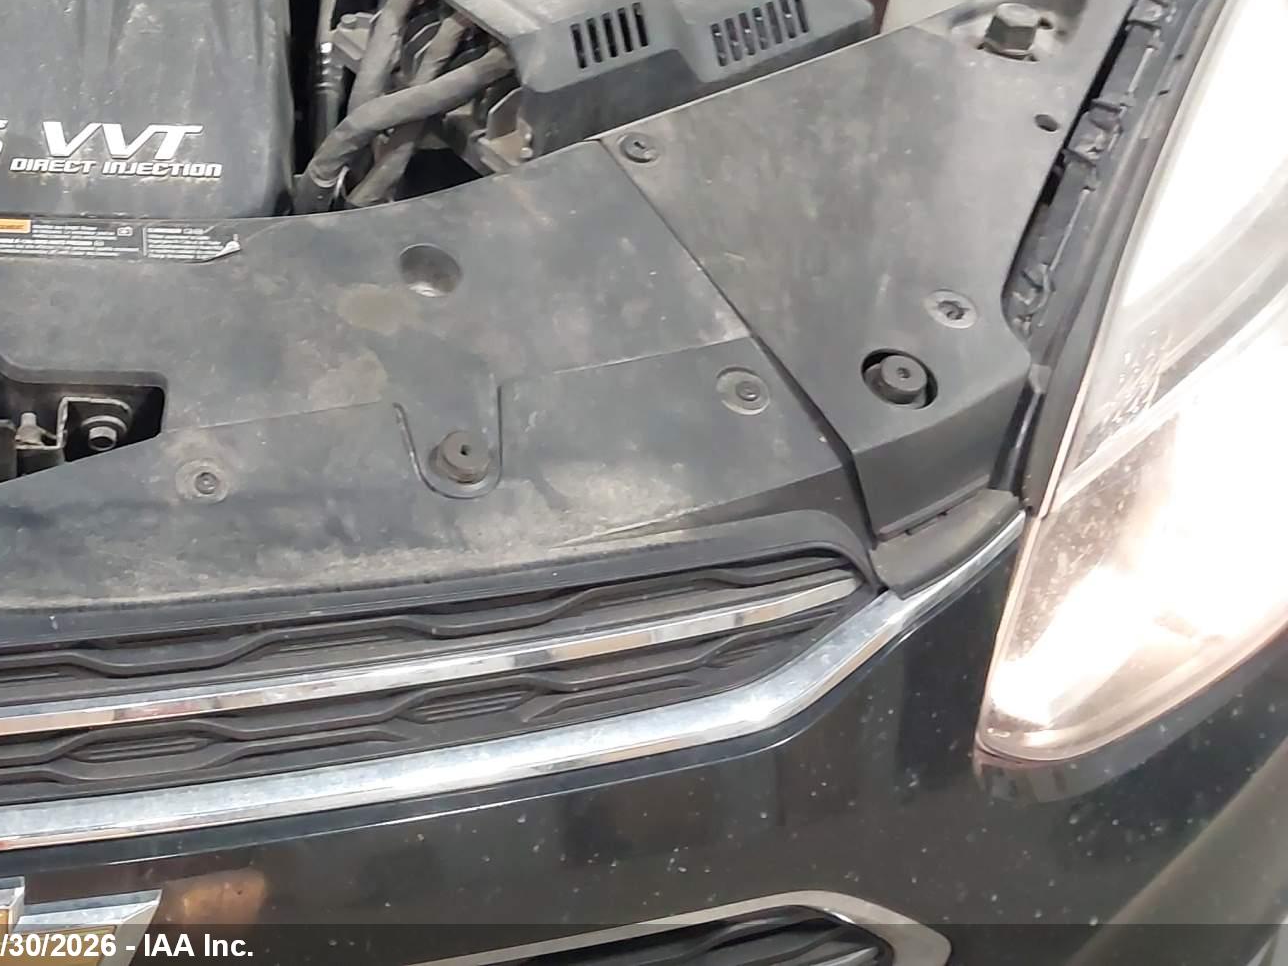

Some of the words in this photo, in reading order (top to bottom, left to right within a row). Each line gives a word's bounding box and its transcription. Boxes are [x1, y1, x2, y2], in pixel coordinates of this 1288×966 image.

[42, 121, 204, 160] VVT
[10, 157, 96, 174] DIRECT
[102, 159, 223, 178] INJECTION
